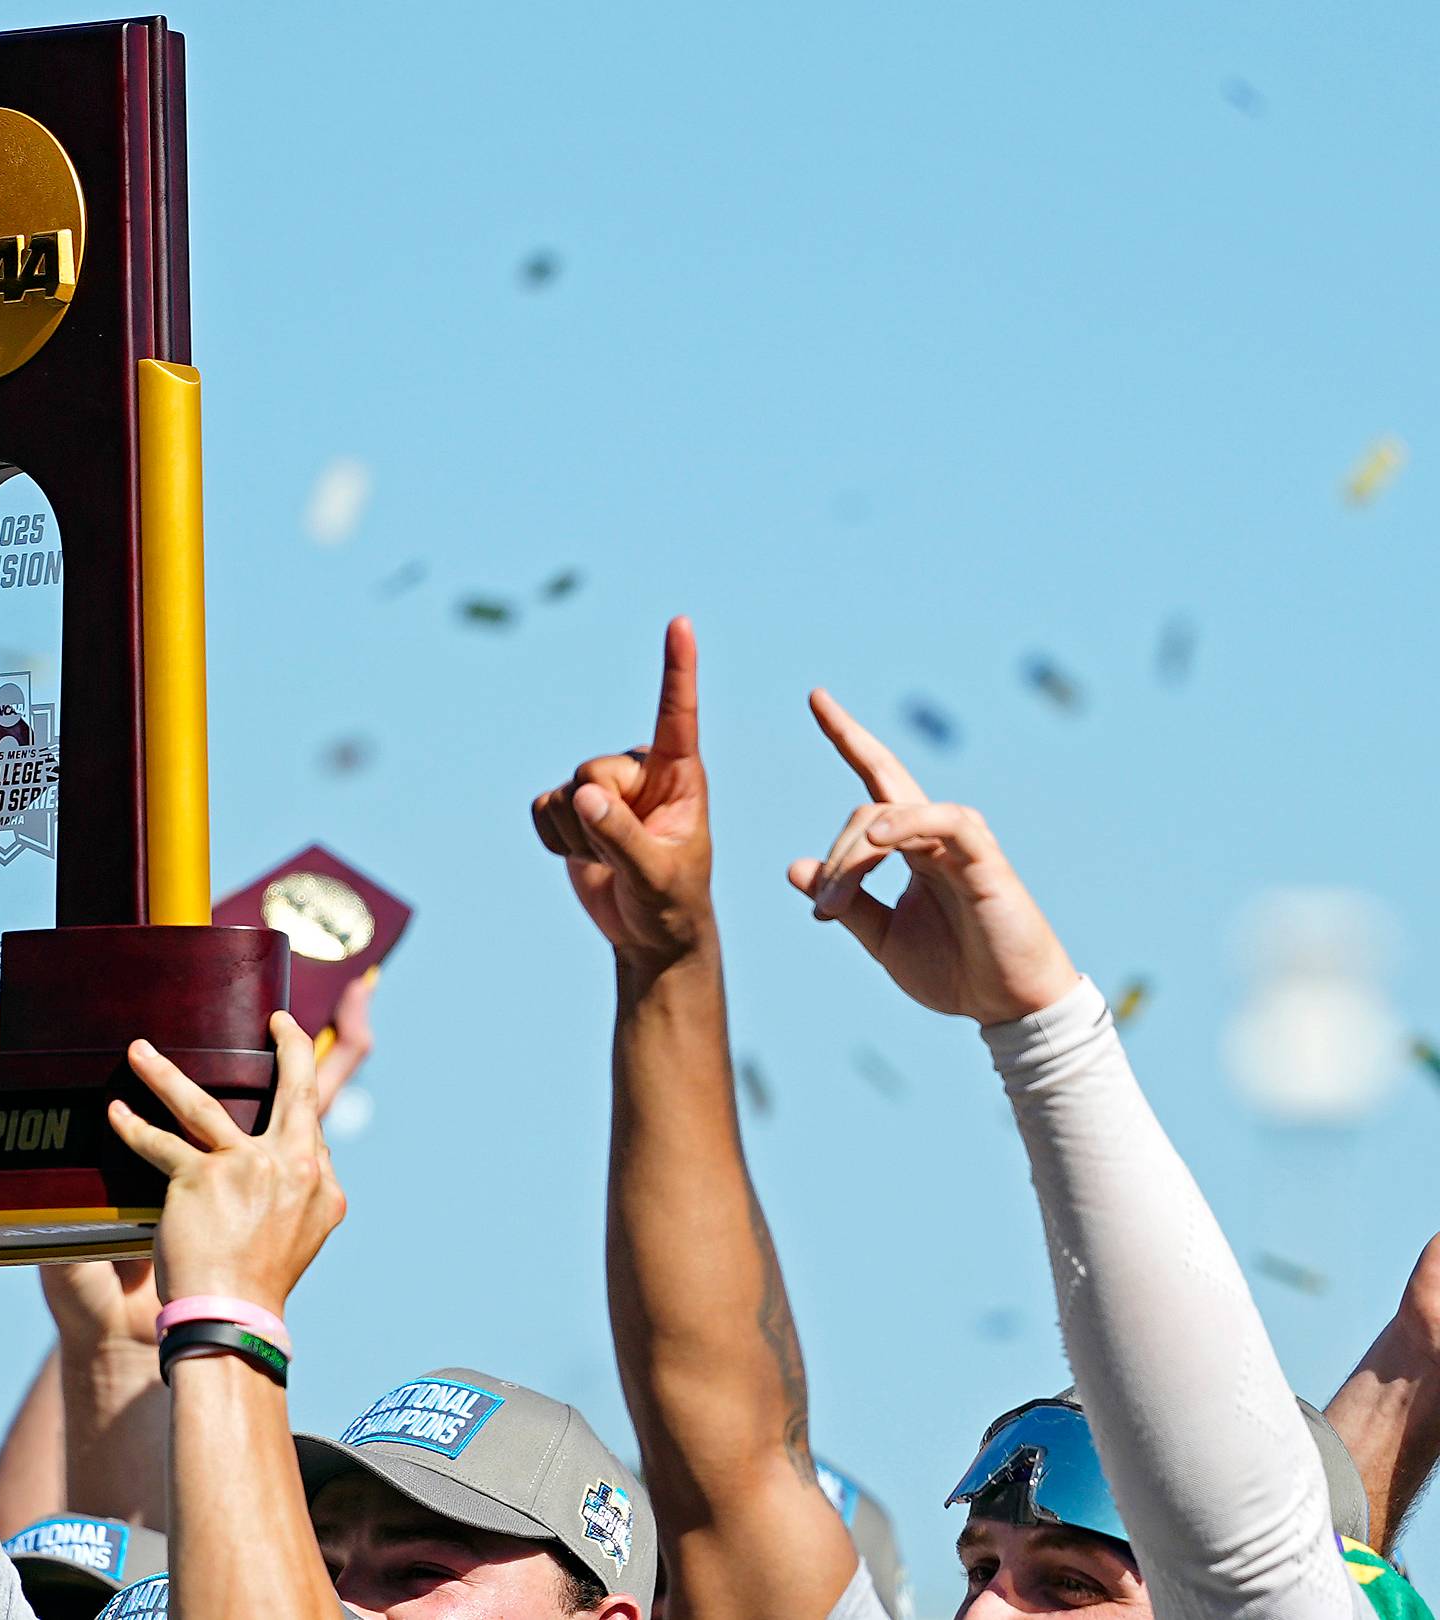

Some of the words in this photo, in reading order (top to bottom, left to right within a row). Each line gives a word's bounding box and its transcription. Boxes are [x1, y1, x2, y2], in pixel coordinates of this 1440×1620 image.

[7, 749, 37, 760] MEN'S
[7, 785, 59, 812] SERIE
[369, 1383, 480, 1419] NATIONAL
[346, 1409, 466, 1444] CHAMPIONS
